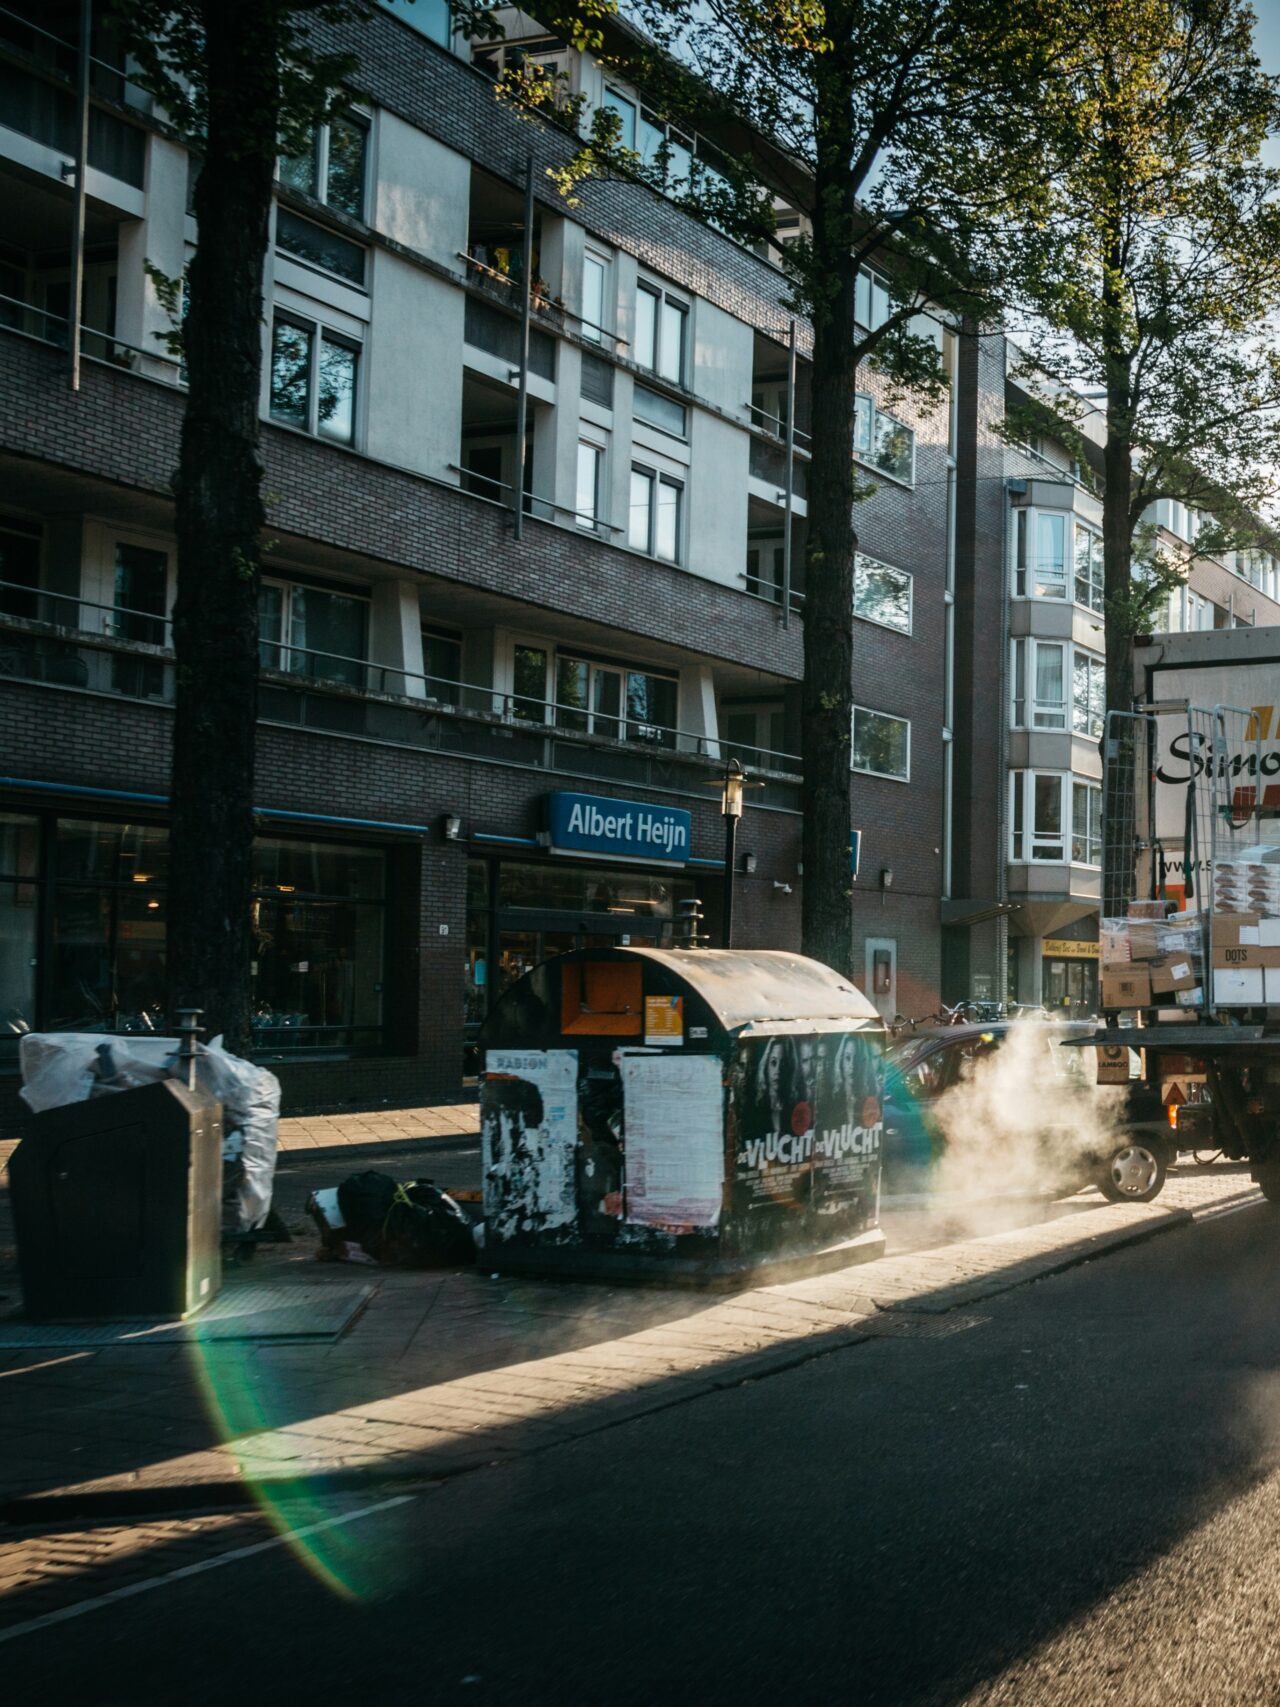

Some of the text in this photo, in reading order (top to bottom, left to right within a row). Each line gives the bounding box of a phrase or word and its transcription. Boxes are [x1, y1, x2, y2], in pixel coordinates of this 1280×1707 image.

[567, 803, 686, 853] Albert Heijn
[1225, 949, 1248, 962] DOTS
[744, 1129, 814, 1170] VLUCHT
[822, 1121, 883, 1160] VLUCHT
